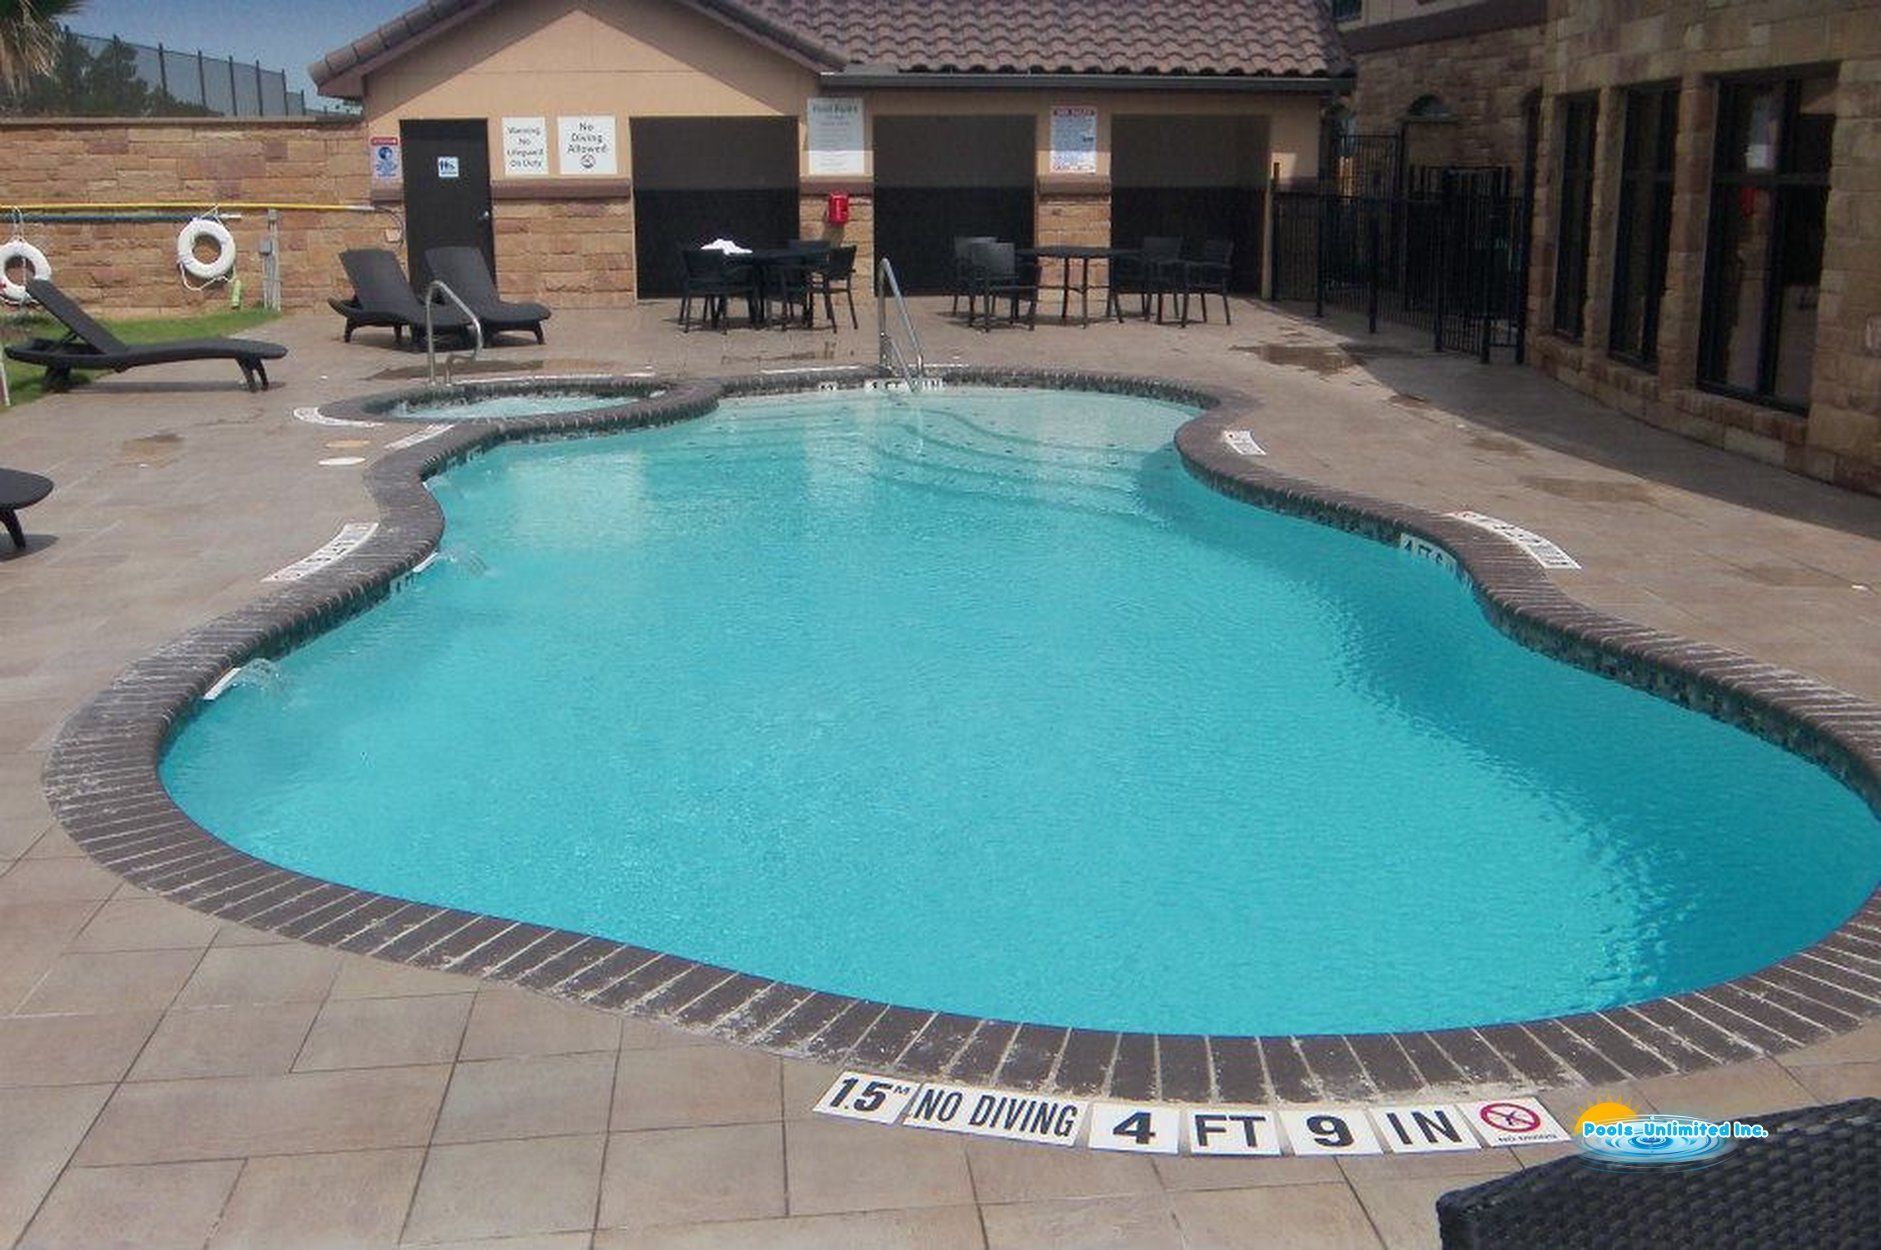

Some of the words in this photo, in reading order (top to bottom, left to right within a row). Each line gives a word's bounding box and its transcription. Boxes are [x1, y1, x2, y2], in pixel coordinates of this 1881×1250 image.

[507, 127, 541, 136] Warning
[579, 122, 594, 132] No
[519, 138, 531, 146] No
[571, 132, 603, 143] Diving
[567, 143, 608, 153] Allowed
[912, 1087, 964, 1124] NO
[968, 1093, 1080, 1138] DIVING
[1112, 1111, 1157, 1145] 4
[1193, 1114, 1268, 1147] FT
[1305, 1114, 1357, 1148] 9
[1384, 1110, 1464, 1146] IN
